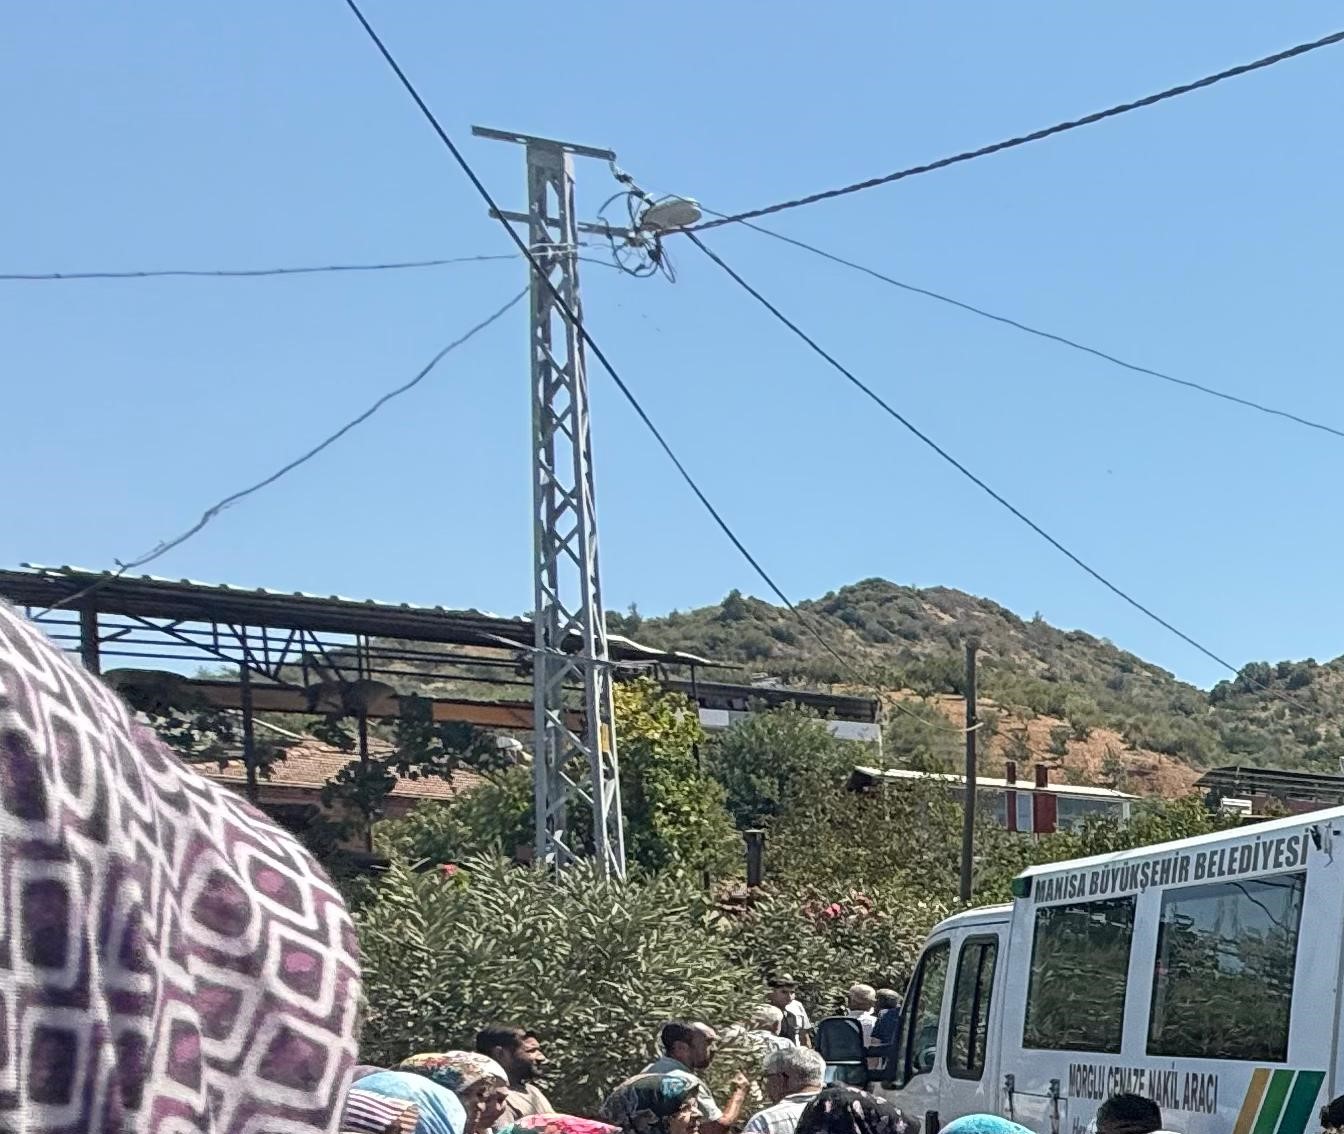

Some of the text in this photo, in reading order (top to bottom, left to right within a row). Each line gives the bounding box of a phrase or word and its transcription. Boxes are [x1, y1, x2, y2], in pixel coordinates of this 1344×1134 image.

[1034, 828, 1310, 903] MANİSA BÜYÜKŞEHİR BELEDİYESİ
[1069, 1063, 1105, 1099] MORGLU
[1149, 1061, 1179, 1110] NAKİL
[1182, 1072, 1218, 1114] ARACI
